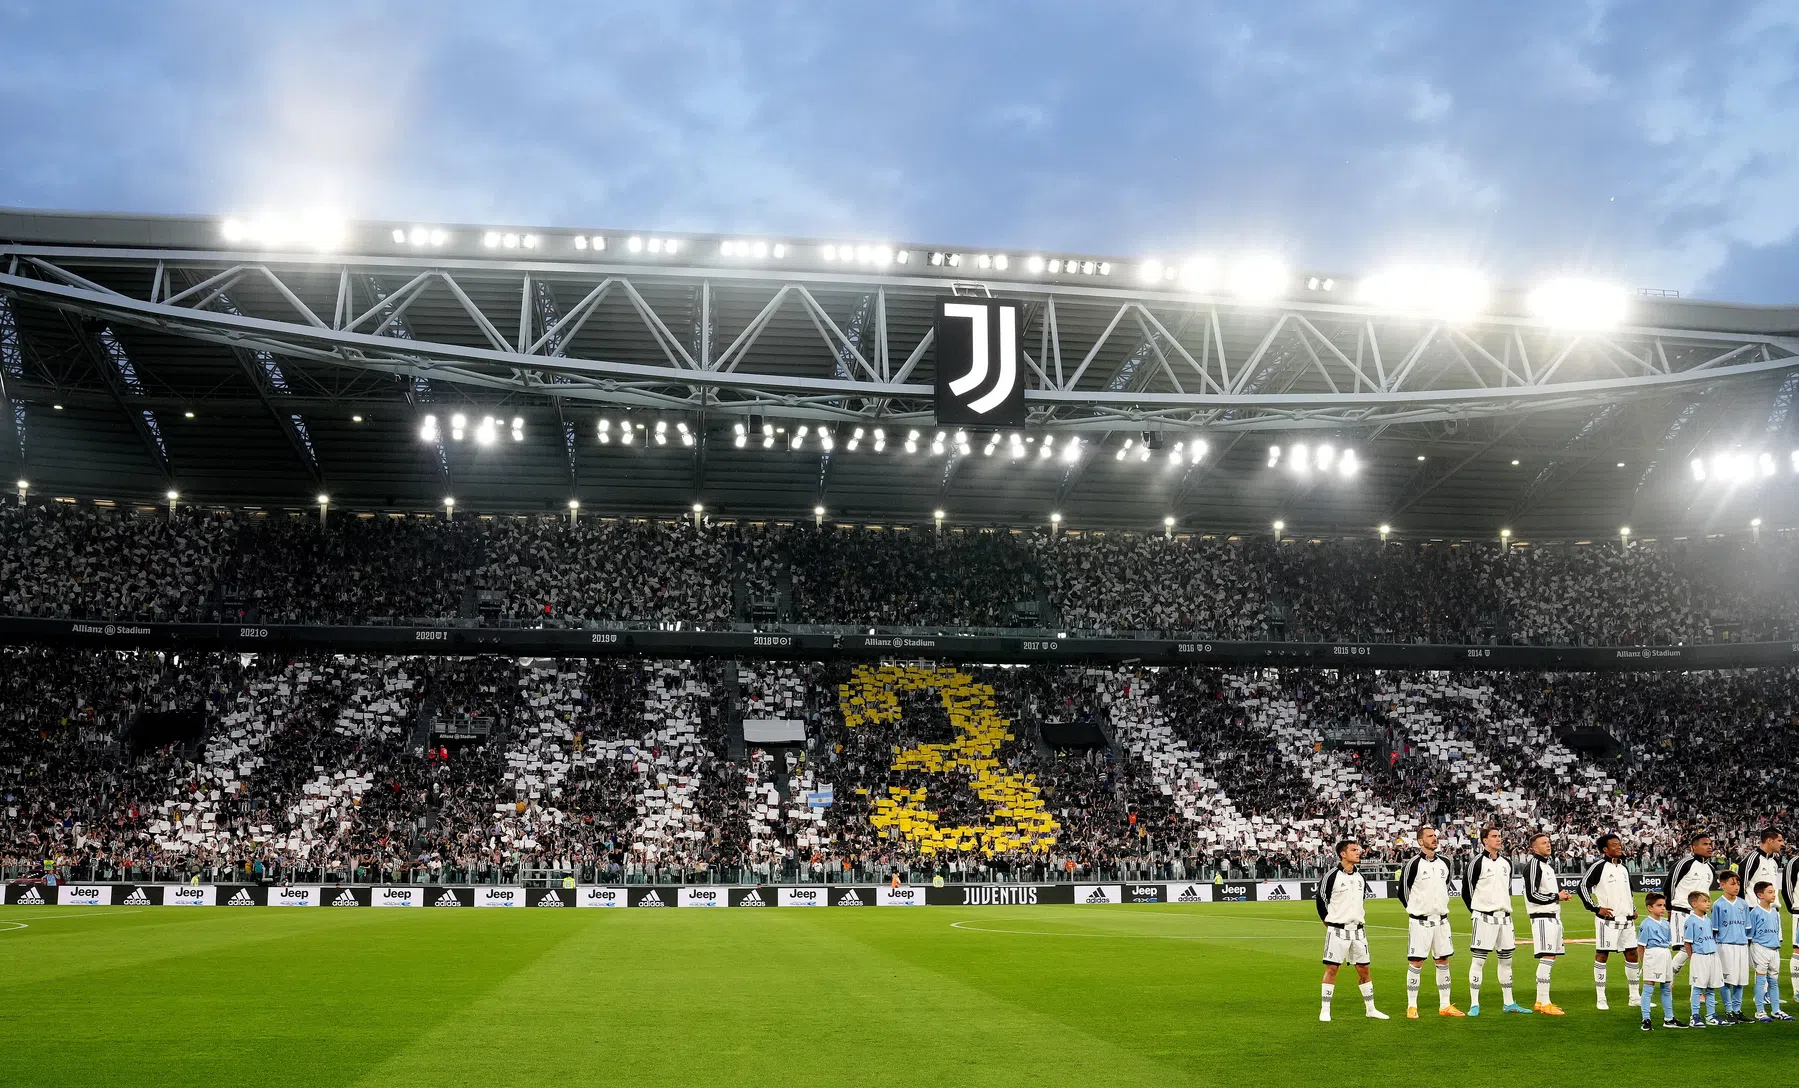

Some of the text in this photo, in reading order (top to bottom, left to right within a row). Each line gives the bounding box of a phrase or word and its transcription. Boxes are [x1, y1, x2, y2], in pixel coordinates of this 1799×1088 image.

[72, 625, 102, 633] Allianz
[240, 628, 259, 637] 2021
[592, 634, 609, 642] 2019
[754, 637, 771, 645] 2018
[1640, 876, 1661, 886] Jeep
[70, 887, 99, 898] Jeep
[176, 887, 203, 898] Jeep
[281, 889, 308, 900] Jeep
[384, 889, 411, 900] Jeep
[486, 889, 514, 900] Jeep
[588, 889, 615, 900] Jeep
[689, 889, 716, 900] Jeep
[790, 889, 816, 900] Jeep
[888, 888, 914, 899] Jeep
[963, 887, 1037, 904] JUVENTUS
[1132, 886, 1157, 896] Jeep
[1222, 885, 1246, 895] Jeep
